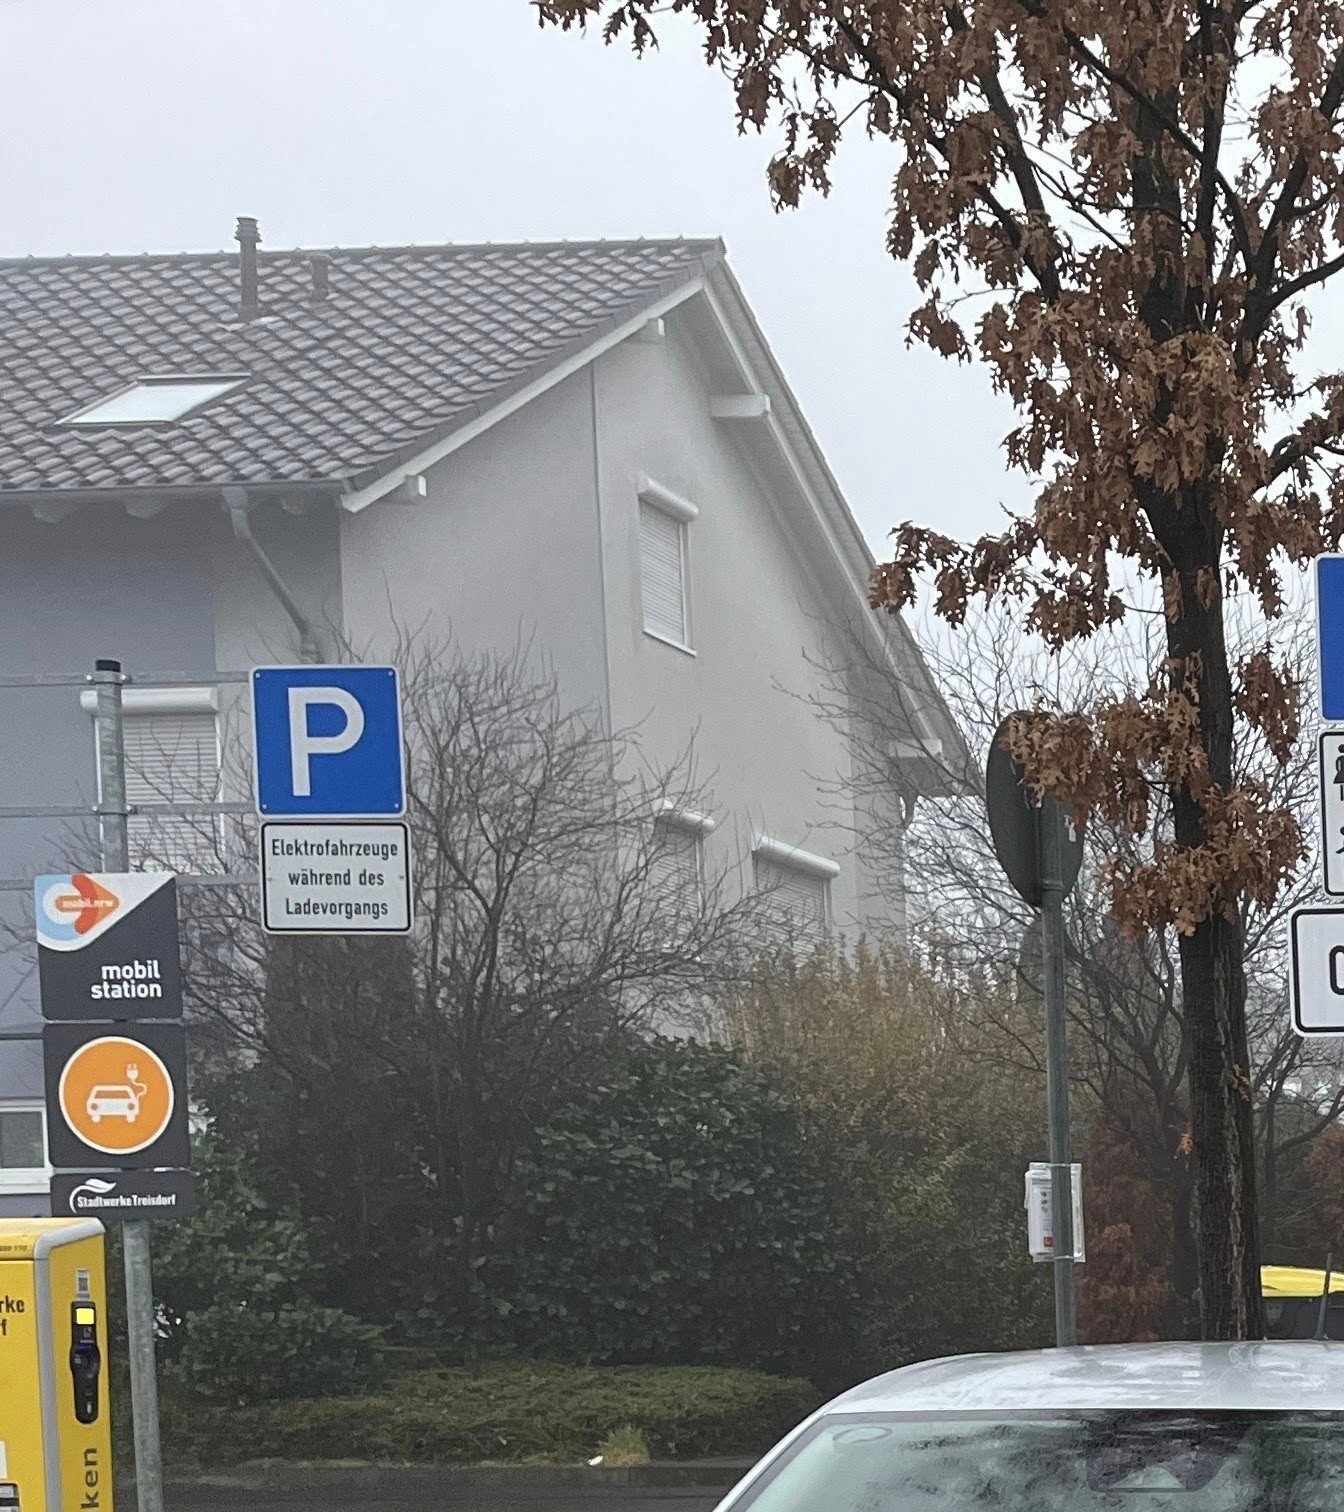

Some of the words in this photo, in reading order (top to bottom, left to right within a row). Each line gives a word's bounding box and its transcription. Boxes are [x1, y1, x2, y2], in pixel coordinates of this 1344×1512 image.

[287, 685, 365, 797] P
[271, 838, 398, 861] Elektrofahrzeuge
[287, 867, 351, 886] während
[358, 867, 385, 886] des
[285, 897, 389, 920] Ladevorgangs
[101, 959, 161, 980] mobil
[90, 979, 162, 999] station
